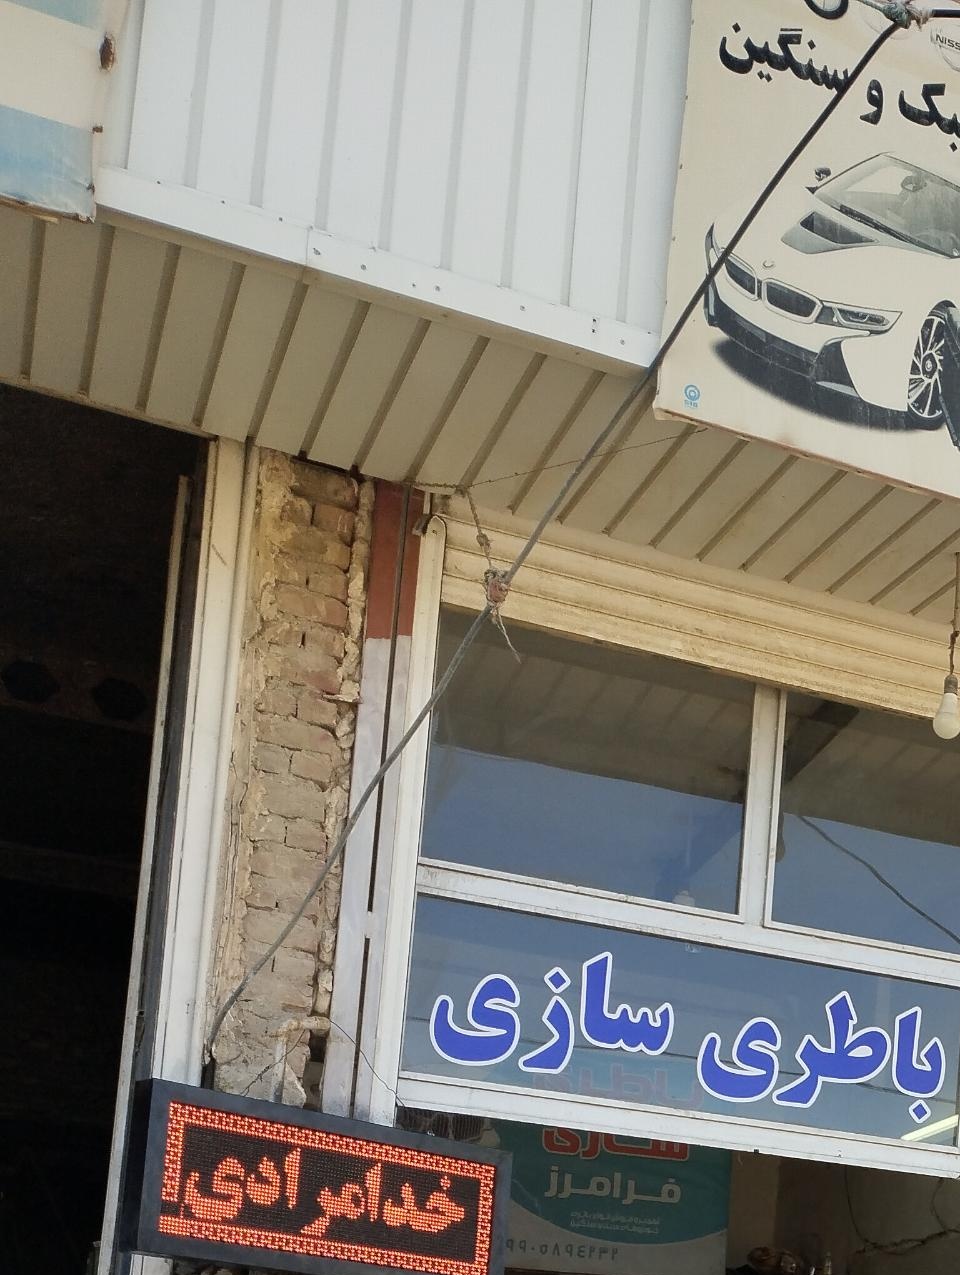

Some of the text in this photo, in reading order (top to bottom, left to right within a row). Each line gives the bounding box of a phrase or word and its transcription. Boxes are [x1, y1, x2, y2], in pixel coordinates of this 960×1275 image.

[719, 22, 850, 94] سنگین
[860, 79, 884, 126] و
[428, 950, 946, 1124] باطری سازی
[543, 1165, 682, 1206] فرامرز
